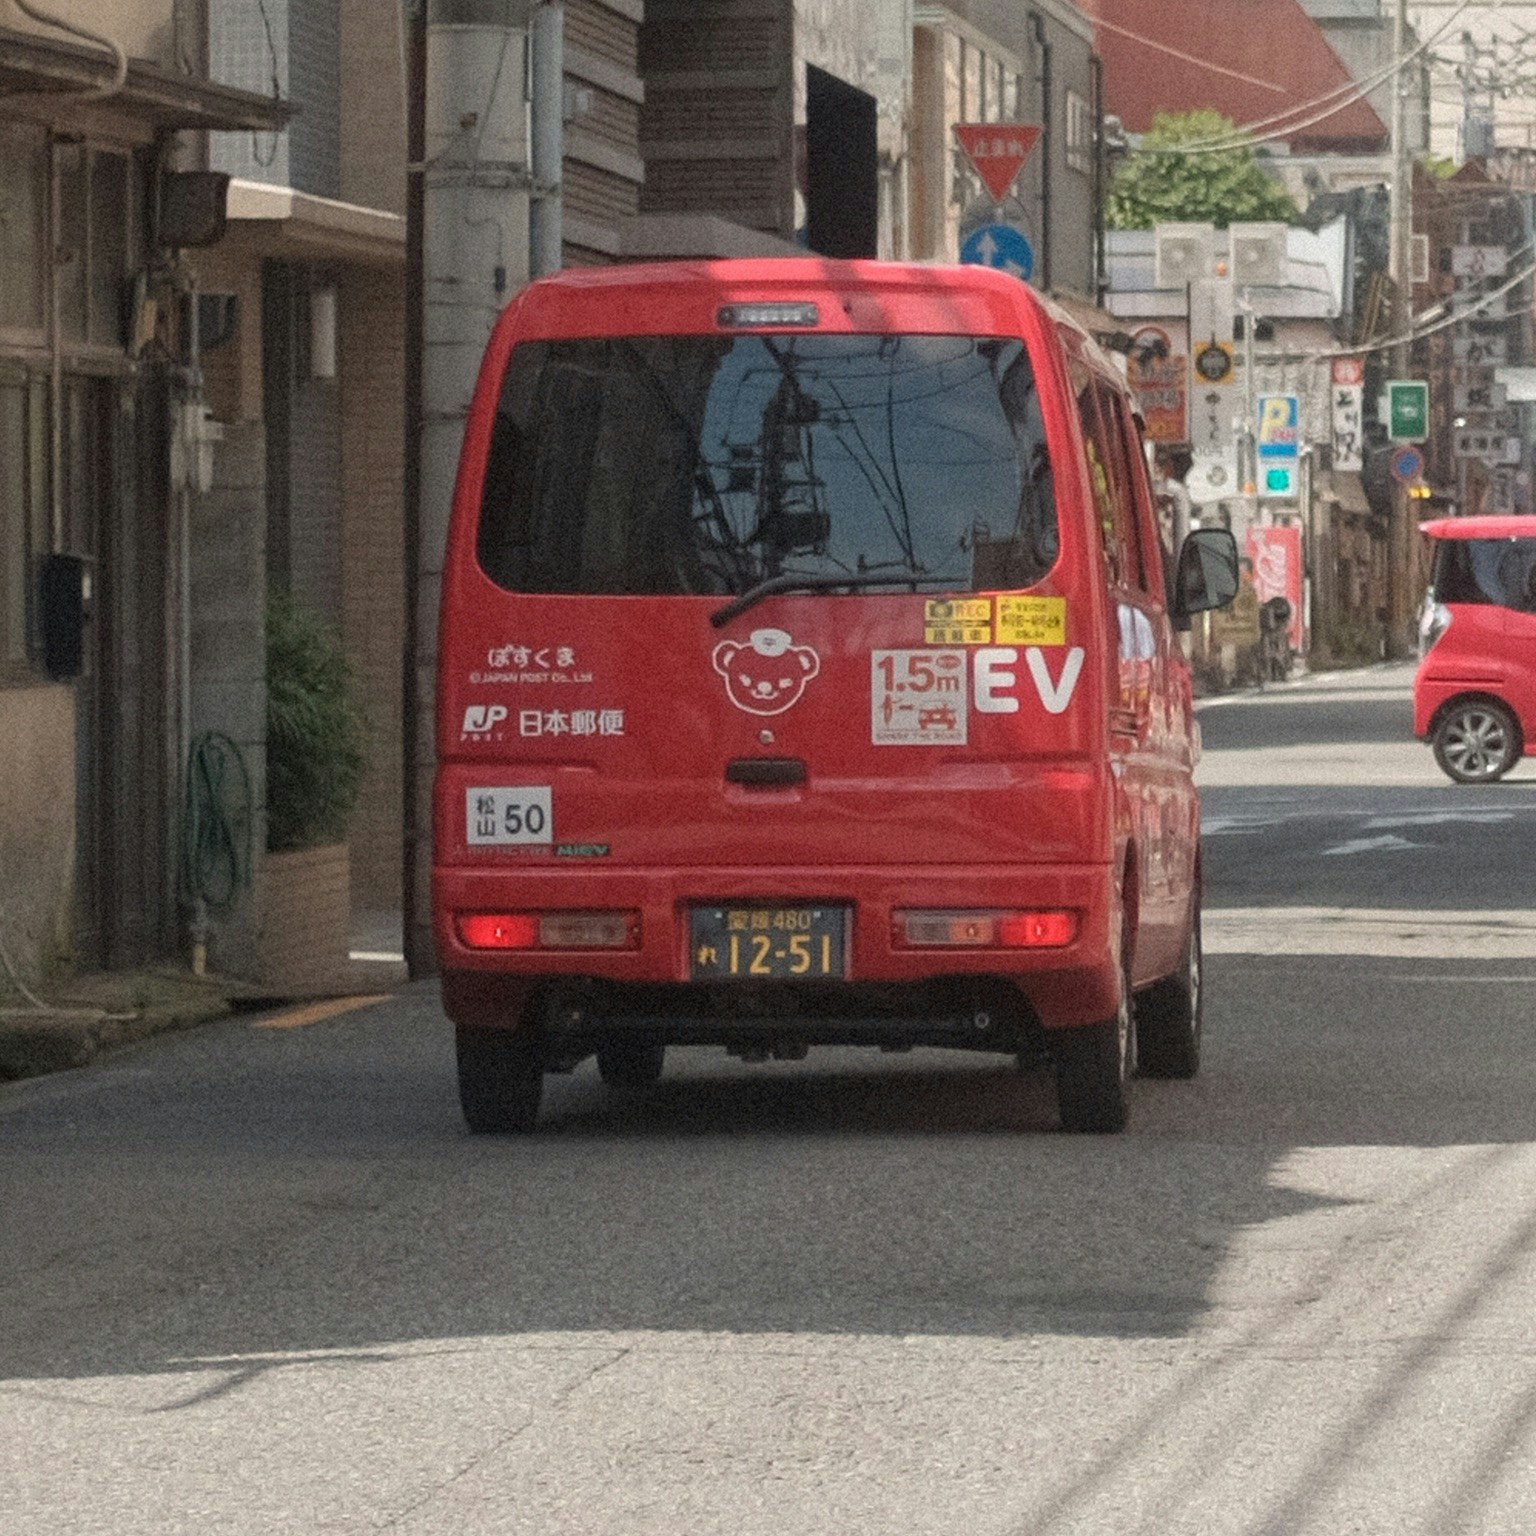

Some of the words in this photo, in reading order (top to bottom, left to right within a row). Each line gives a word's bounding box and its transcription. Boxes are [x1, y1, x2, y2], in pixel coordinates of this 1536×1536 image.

[487, 644, 576, 668] ぽすくま
[482, 672, 518, 683] JAPAN
[520, 672, 549, 683] POST
[973, 647, 1085, 714] EV
[459, 731, 503, 742] POST
[519, 709, 625, 737] 日本郵便
[476, 795, 496, 837] 松山
[504, 804, 545, 835] 50
[772, 910, 812, 931] 480
[729, 934, 831, 975] 12-51
